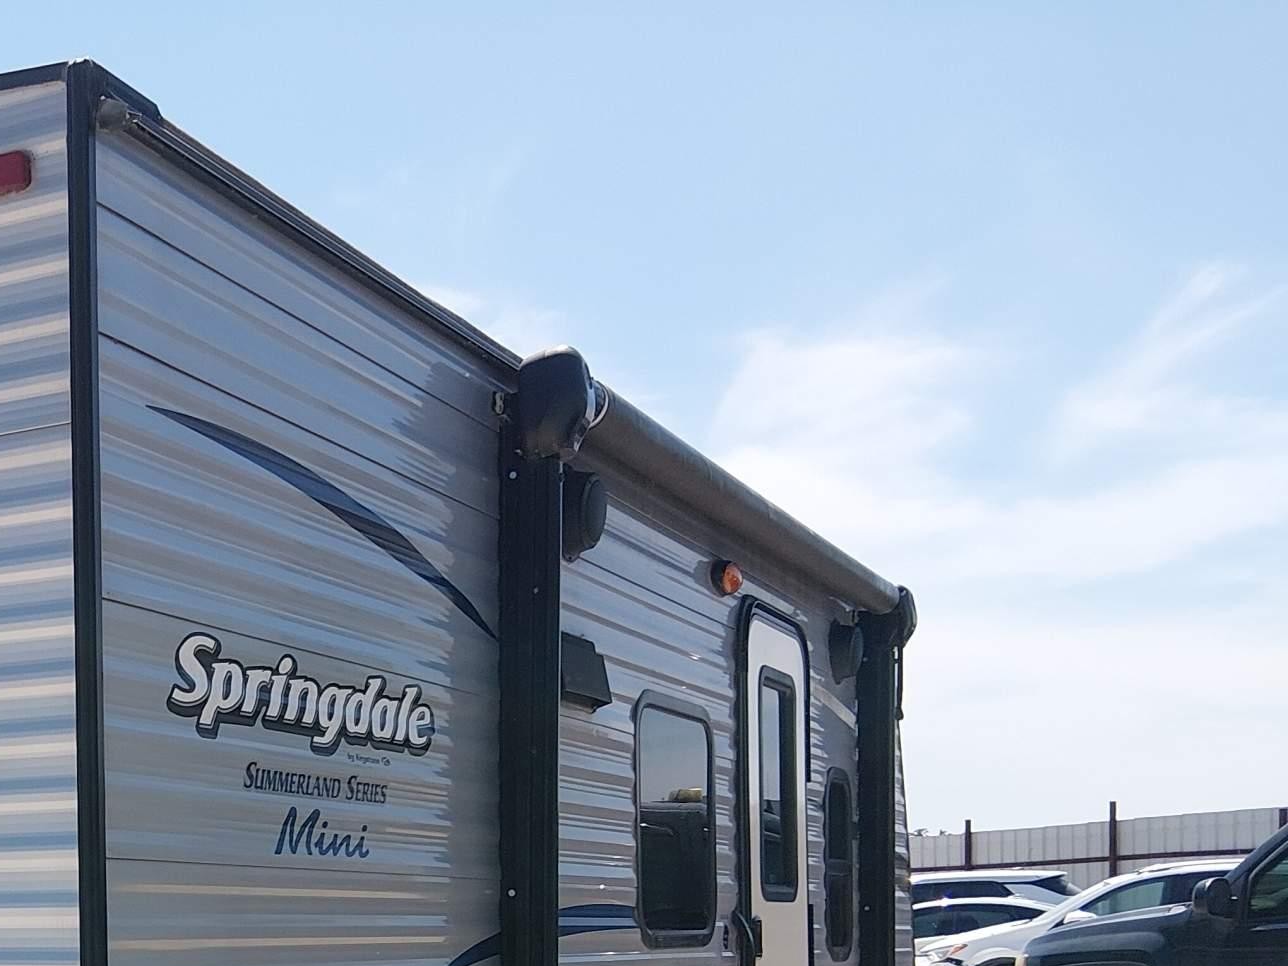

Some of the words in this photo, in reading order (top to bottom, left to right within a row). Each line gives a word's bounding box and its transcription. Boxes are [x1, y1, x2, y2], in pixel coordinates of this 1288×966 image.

[166, 632, 436, 757] Springdale
[243, 761, 341, 799] SUMMERLAND
[345, 775, 388, 804] SERIES
[274, 806, 370, 859] Mini
